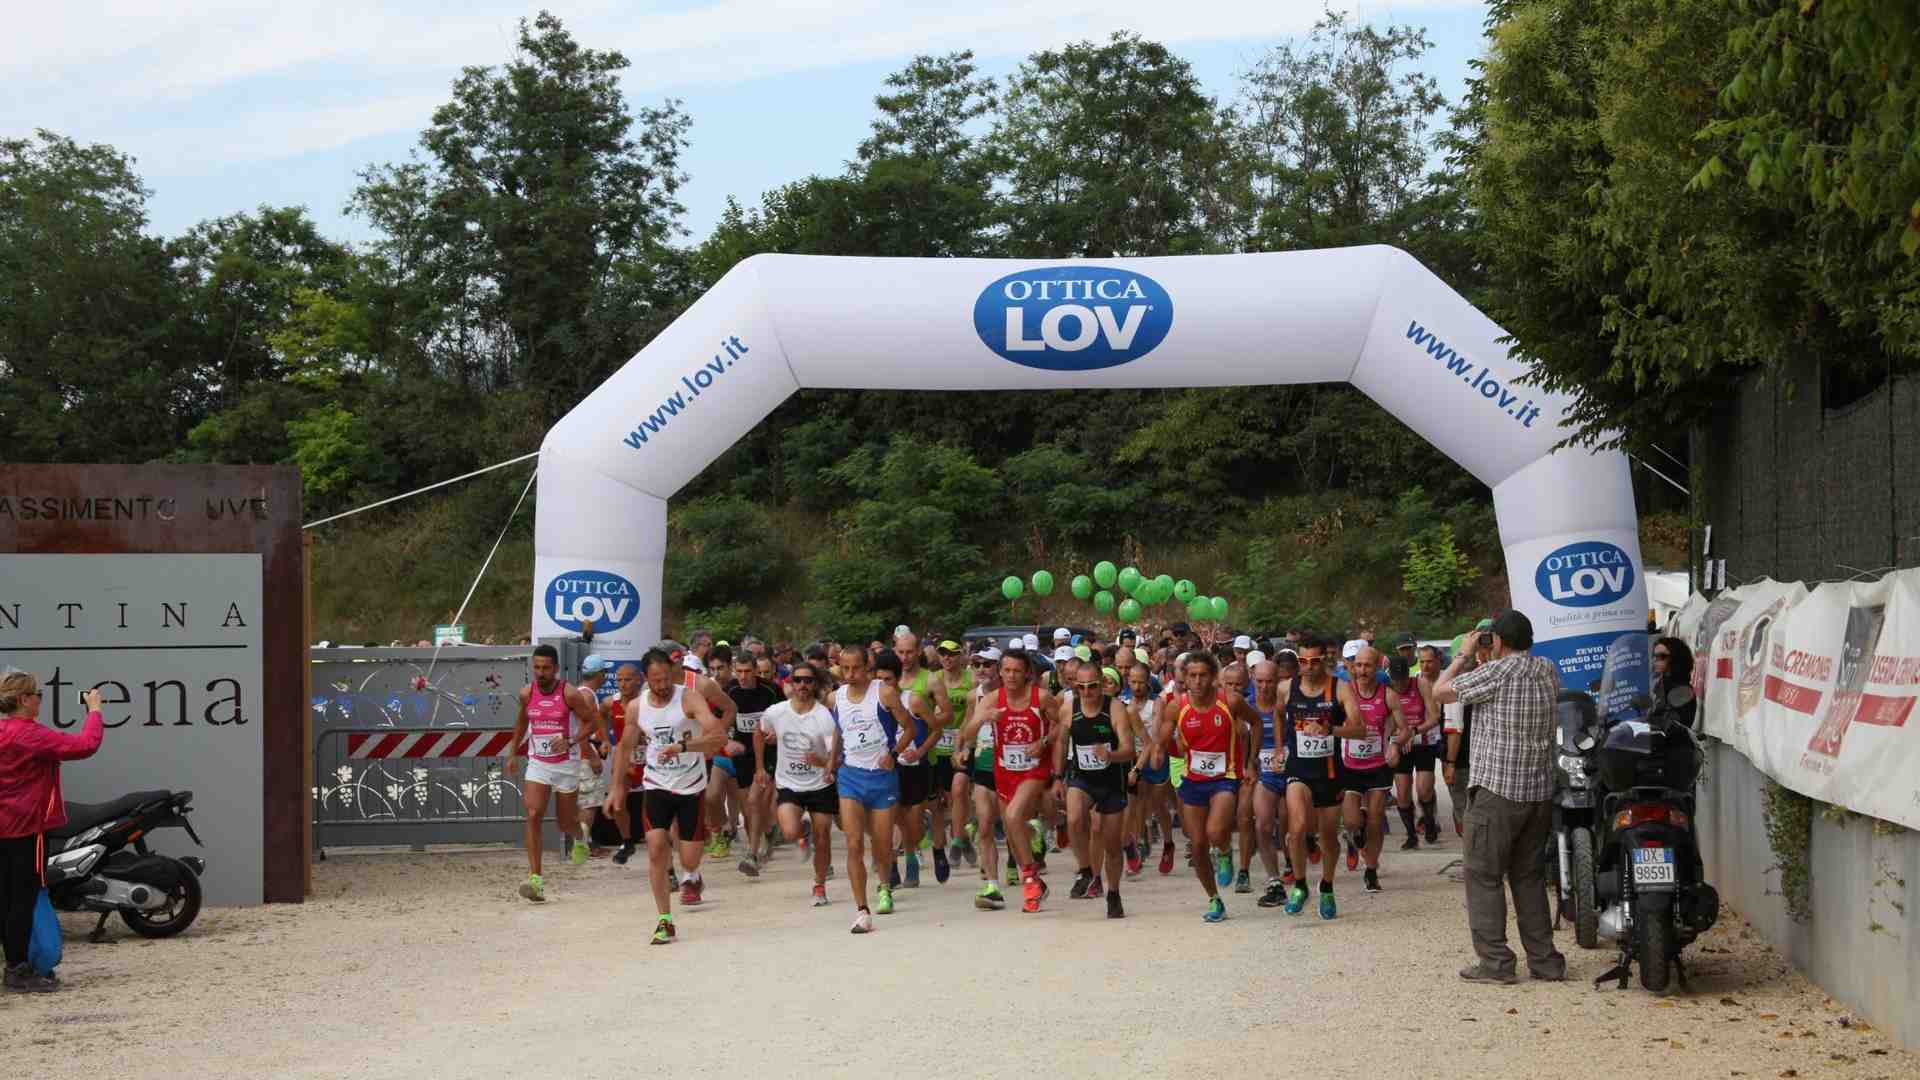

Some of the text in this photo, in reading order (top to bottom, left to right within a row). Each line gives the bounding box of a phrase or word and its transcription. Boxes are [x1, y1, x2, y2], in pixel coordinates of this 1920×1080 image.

[1004, 279, 1147, 301] OTTICA
[1005, 304, 1148, 352] LOV
[1406, 320, 1541, 428] www.lov.it
[623, 336, 749, 450] www.lov.it
[206, 498, 269, 521] UVE
[1546, 550, 1624, 571] OTTICA
[555, 579, 630, 595] OTTICA
[1550, 567, 1625, 600] LOV
[0, 601, 247, 629] NTINA
[555, 596, 630, 623] LOV
[1575, 646, 1604, 656] ZEVIO
[1559, 655, 1591, 666] CORSO
[1561, 664, 1582, 673] TEL.
[858, 732, 867, 743] 2
[1303, 740, 1328, 750] 974
[1358, 744, 1373, 752] 92
[1199, 760, 1216, 770] 36
[1636, 866, 1671, 880] 98591
